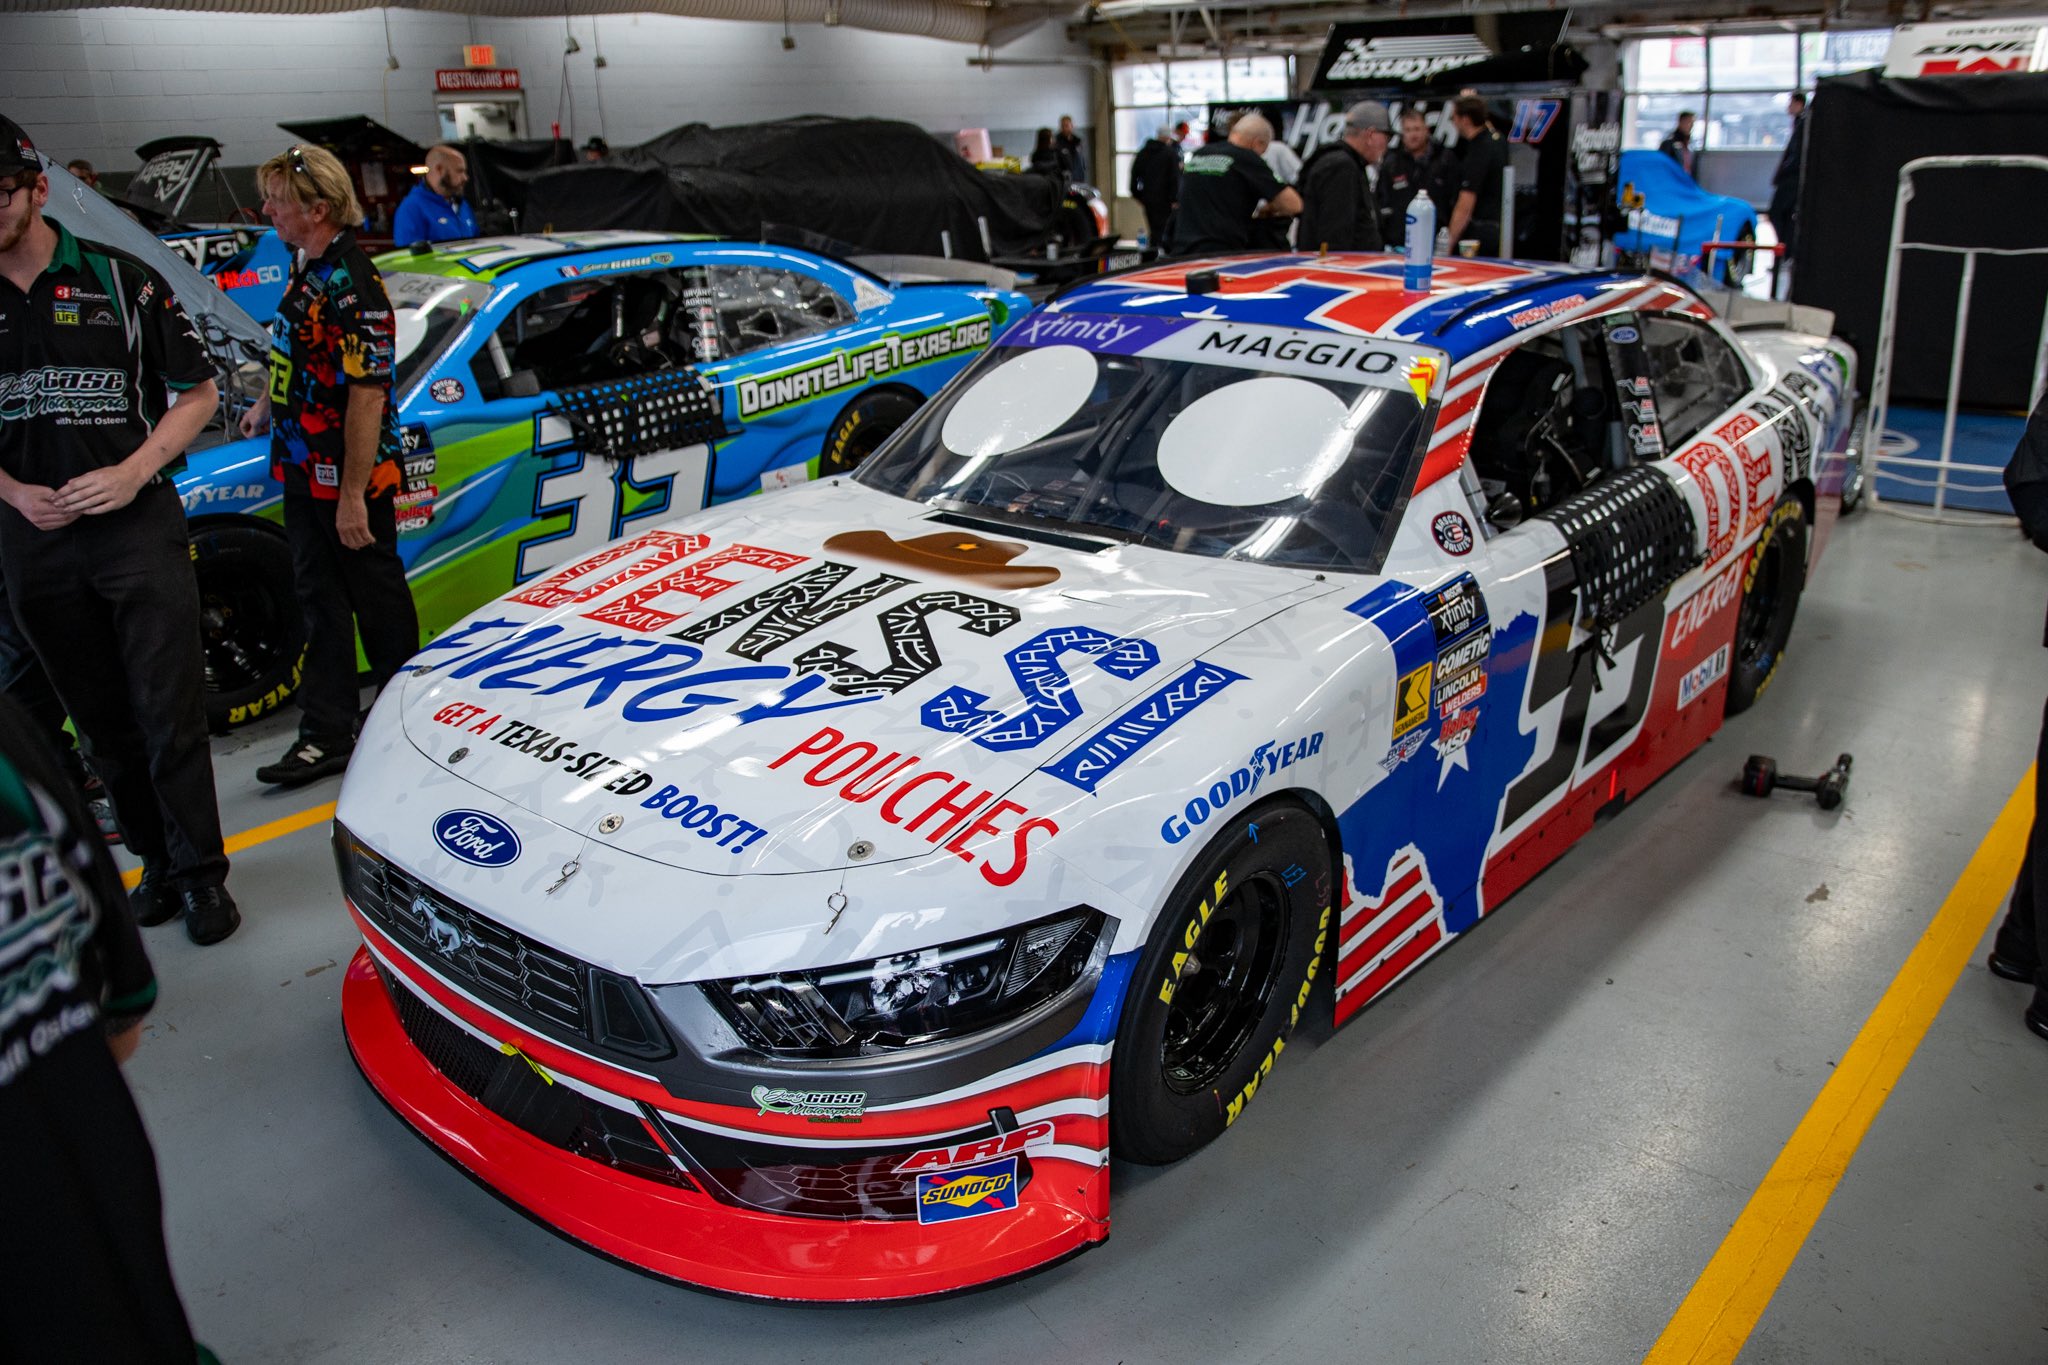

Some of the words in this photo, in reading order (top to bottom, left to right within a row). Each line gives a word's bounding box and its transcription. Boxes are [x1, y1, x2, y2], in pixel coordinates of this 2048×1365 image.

[440, 72, 502, 88] RESTROOMS
[1508, 99, 1562, 143] 17
[1108, 253, 1141, 272] NASCAR
[71, 292, 112, 300] FABRICATING
[56, 313, 78, 324] LIFE
[364, 310, 388, 319] NASCAR
[1020, 315, 1145, 349] xfinity
[1198, 330, 1399, 375] MAGGIO
[73, 417, 92, 425] cott
[830, 409, 862, 465] EAGLE
[404, 458, 434, 477] ETIC
[1434, 513, 1463, 532] NASCAR
[1440, 595, 1476, 633] xfinity
[1454, 617, 1470, 635] SERIES
[1436, 632, 1491, 680] COMETIC
[400, 617, 884, 734] ENERGY
[1436, 668, 1480, 704] LINCOLN
[1681, 660, 1714, 700] Mobil
[1445, 683, 1483, 714] WELDERS
[1440, 706, 1480, 741] Holley
[1437, 727, 1472, 758] MSD
[432, 702, 495, 729] GET
[467, 714, 503, 736] A
[489, 720, 653, 796] TEXAS-SIZED
[639, 784, 768, 854] BOOST!
[1160, 731, 1325, 845] GOODYEAR
[767, 726, 1060, 887] POUCHES
[443, 816, 505, 860] Ford
[1158, 868, 1229, 1006] EAGLE
[786, 1103, 867, 1118] Motorsports
[896, 1122, 1051, 1169] ARP
[924, 1174, 1011, 1205] SUNOCO
